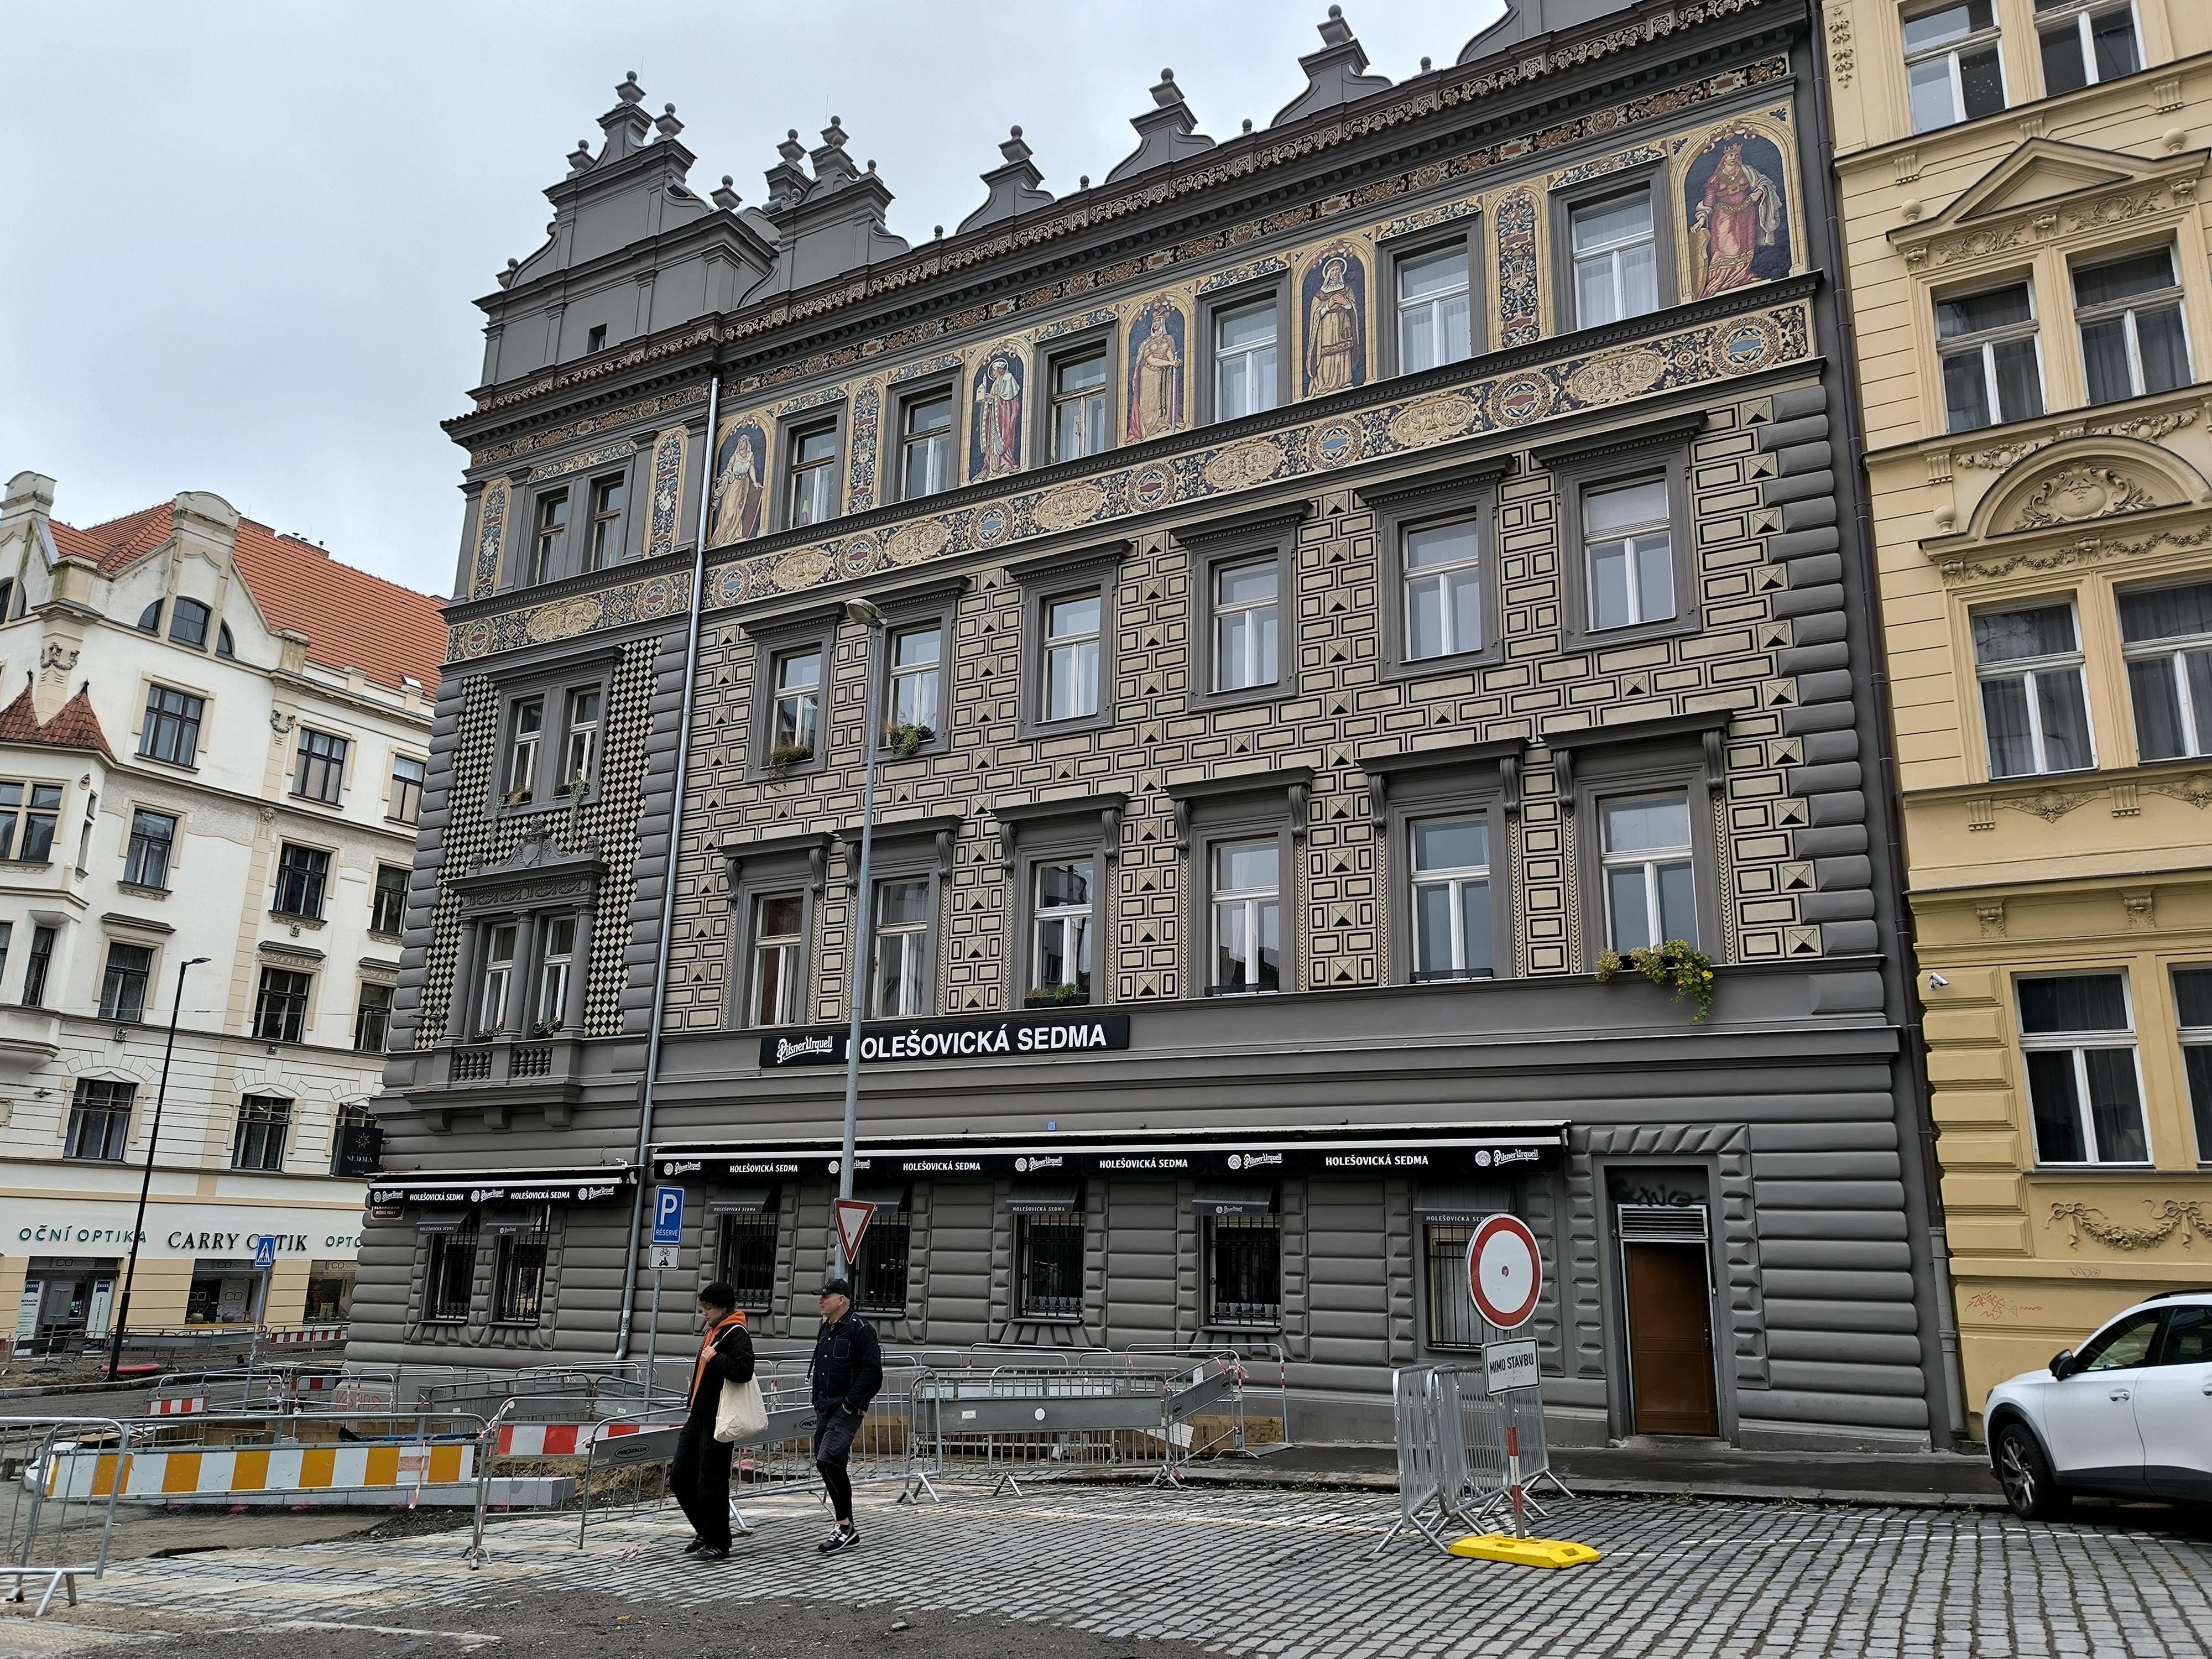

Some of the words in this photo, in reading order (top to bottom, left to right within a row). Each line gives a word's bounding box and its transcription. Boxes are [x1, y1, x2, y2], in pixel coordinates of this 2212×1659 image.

[1018, 1024, 1107, 1051] SEDMA
[777, 1038, 806, 1064] Pilsner
[805, 1035, 833, 1054] Urquell
[1029, 1157, 1046, 1171] Pilsner
[1045, 1156, 1062, 1167] Urquell
[1100, 1157, 1156, 1168] HOLEŠOVICKÁ
[1159, 1159, 1187, 1168] SEDMA
[1244, 1154, 1264, 1168] Pilsner
[1262, 1153, 1282, 1164] Urquell
[1326, 1154, 1391, 1166] HOLEŠOVICKÁ
[1395, 1156, 1428, 1165] SEDMA
[1494, 1150, 1516, 1166] Pilsner
[1515, 1149, 1538, 1161] Urquell
[730, 1163, 774, 1172] HOLEŠOVICKÁ
[903, 1161, 953, 1171] HOLEŠOVICKÁ
[410, 1192, 445, 1201] HOLEŠOVICKÁ
[510, 1190, 549, 1199] HOLEŠOVICKÁ
[660, 1194, 677, 1225] P
[19, 1224, 72, 1241] OČNÍ
[77, 1229, 147, 1243] OPTIKA
[655, 1228, 679, 1237] RÉSERVÉ
[168, 1232, 240, 1249] CARRY
[247, 1233, 309, 1250] OTIK
[225, 1292, 243, 1301] CO
[1490, 1359, 1506, 1374] MIMO
[1507, 1353, 1534, 1369] STAVBU
[617, 1447, 648, 1455] PROZNAK
